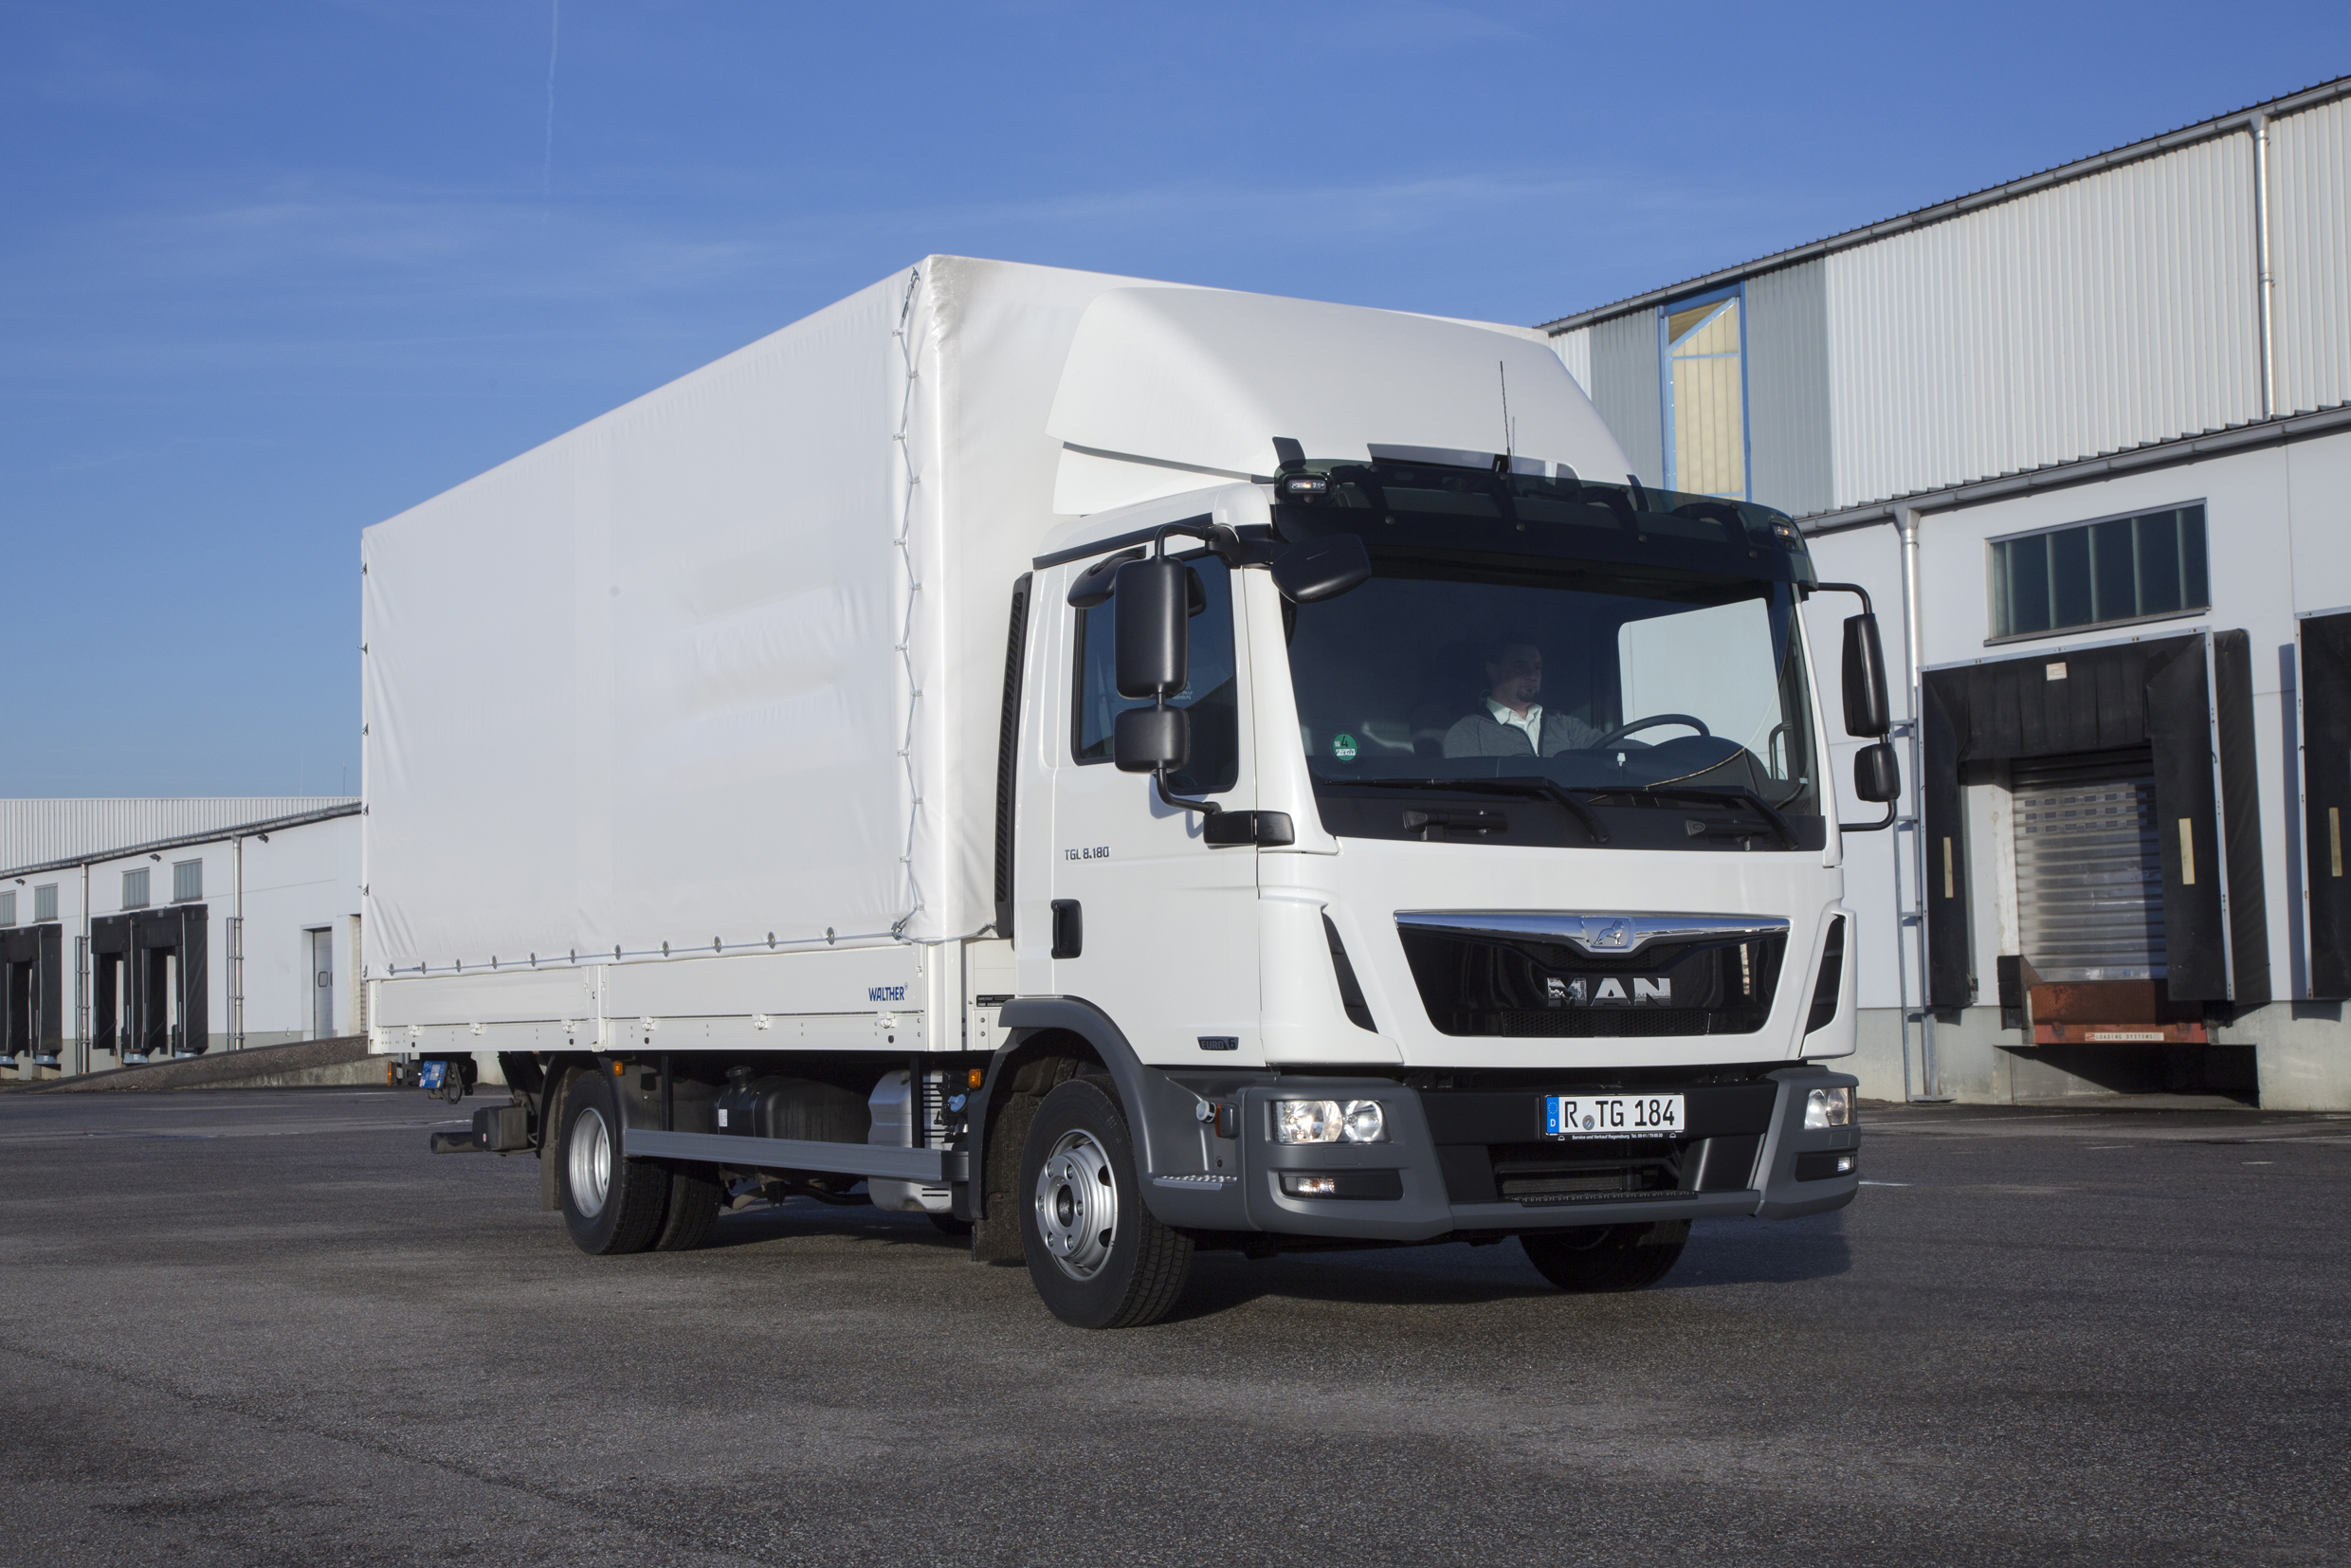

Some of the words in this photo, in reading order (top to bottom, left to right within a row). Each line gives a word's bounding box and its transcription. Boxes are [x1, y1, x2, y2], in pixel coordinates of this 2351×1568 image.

[1340, 736, 1349, 747] 4
[1065, 848, 1082, 861] TGL
[1083, 846, 1110, 859] 8.180
[1547, 977, 1671, 1007] MAN
[1200, 1040, 1225, 1049] EURO
[1228, 1038, 1236, 1049] 6
[1564, 1101, 1578, 1128] R
[1595, 1100, 1624, 1127] TG
[1634, 1099, 1675, 1127] 184
[1550, 1119, 1557, 1127] D
